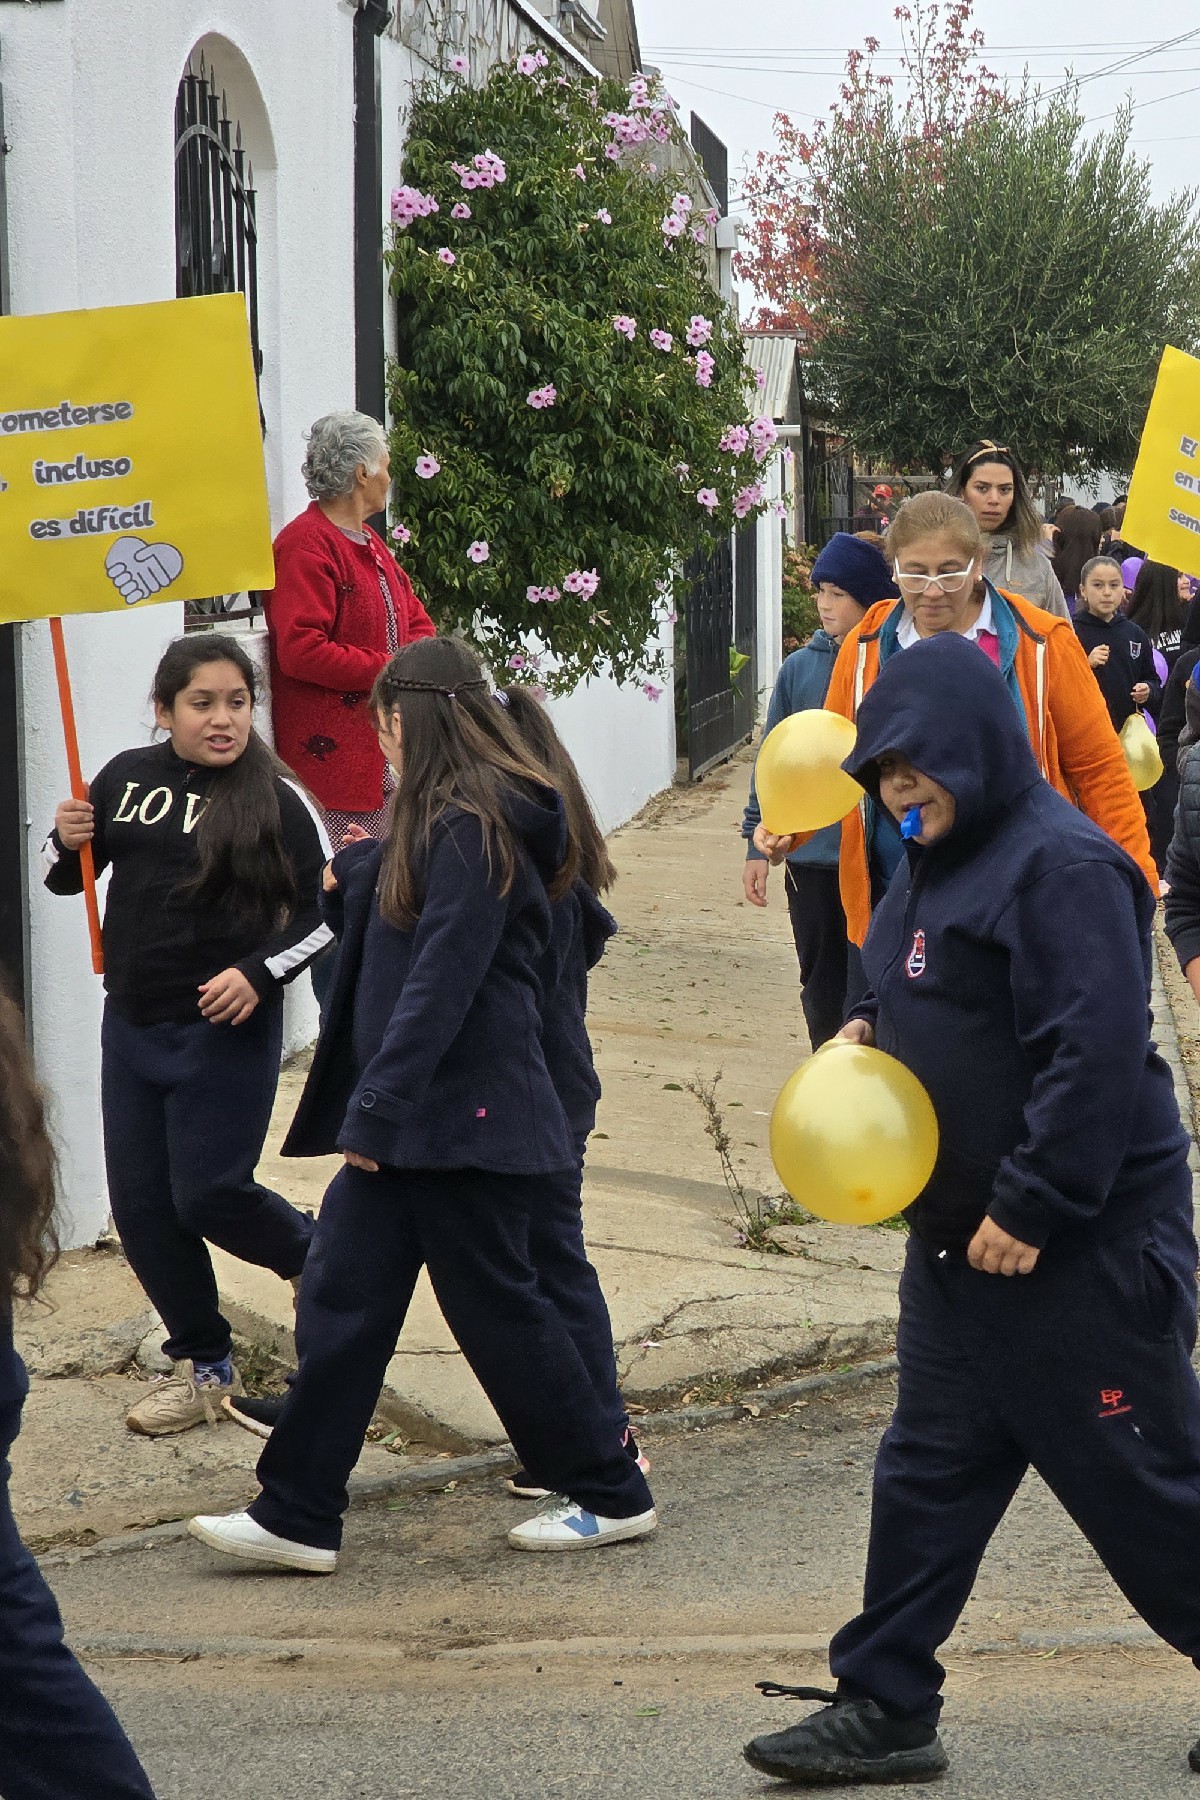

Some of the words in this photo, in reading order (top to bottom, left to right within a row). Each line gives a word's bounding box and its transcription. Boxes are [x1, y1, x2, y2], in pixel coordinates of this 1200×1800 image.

[0, 402, 133, 433] ometerse
[1180, 436, 1199, 458] El
[34, 454, 131, 485] incluso
[1175, 472, 1194, 488] en
[30, 519, 62, 539] es
[68, 501, 155, 535] difícil
[1100, 1389, 1123, 1408] EP
